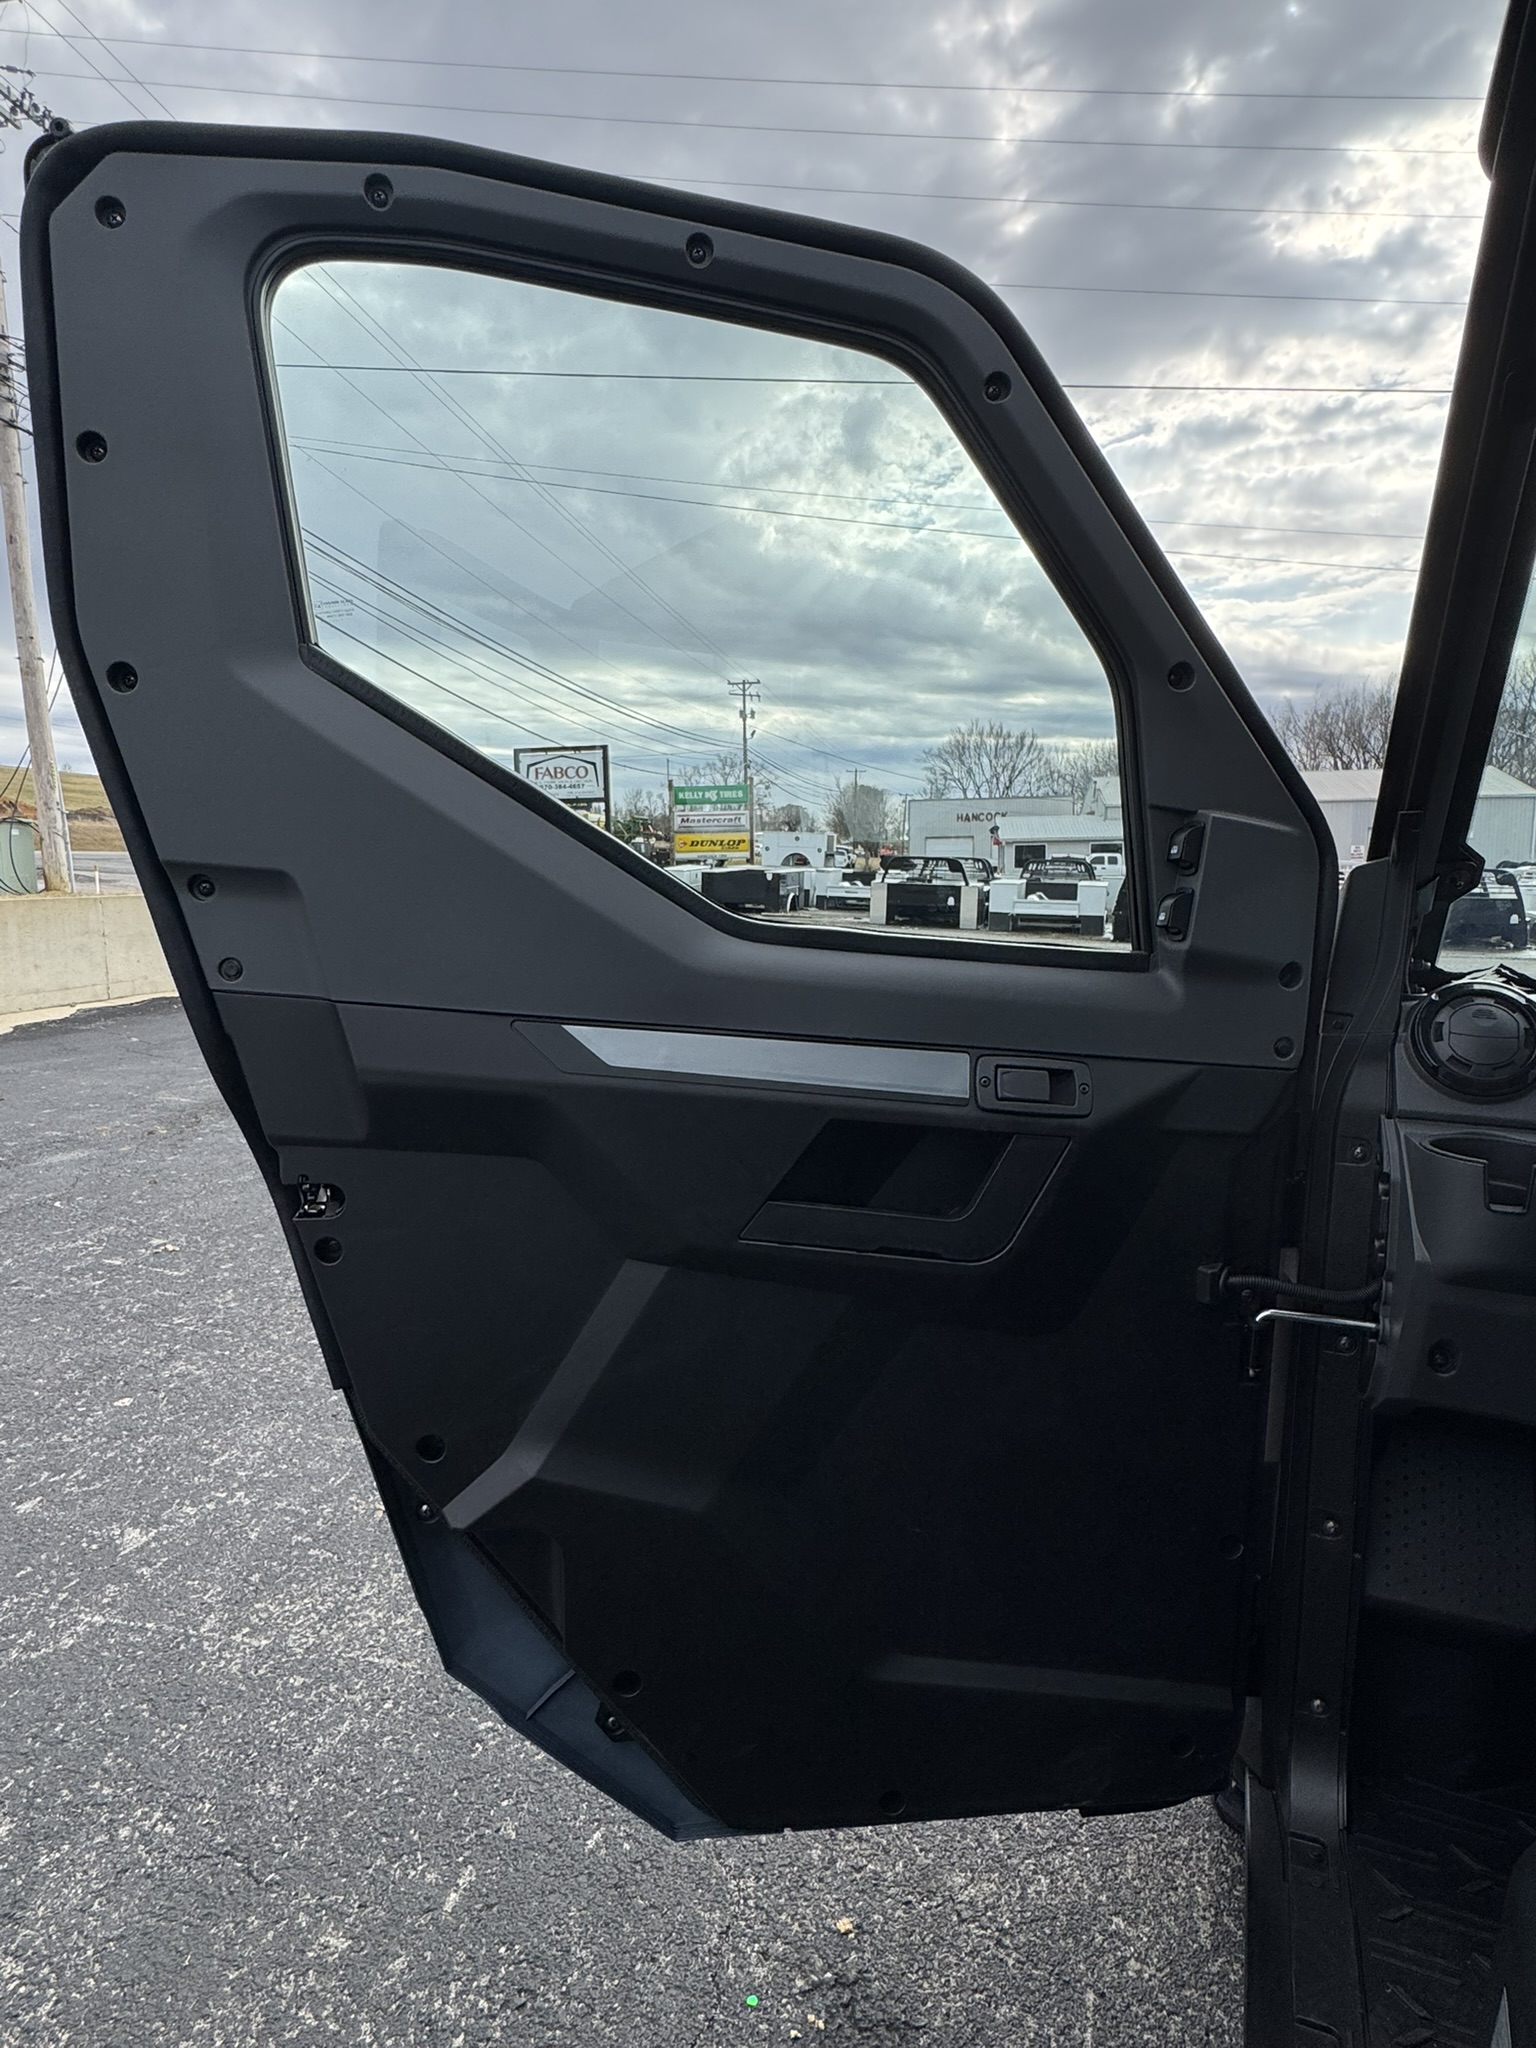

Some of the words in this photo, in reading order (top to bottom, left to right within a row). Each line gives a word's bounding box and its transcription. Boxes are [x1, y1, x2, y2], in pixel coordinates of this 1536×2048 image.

[534, 765, 589, 780] FABCO
[679, 791, 704, 800] KELLY
[719, 790, 743, 798] TIRES
[680, 816, 742, 824] Mastercraft
[689, 839, 746, 847] DUNLOP
